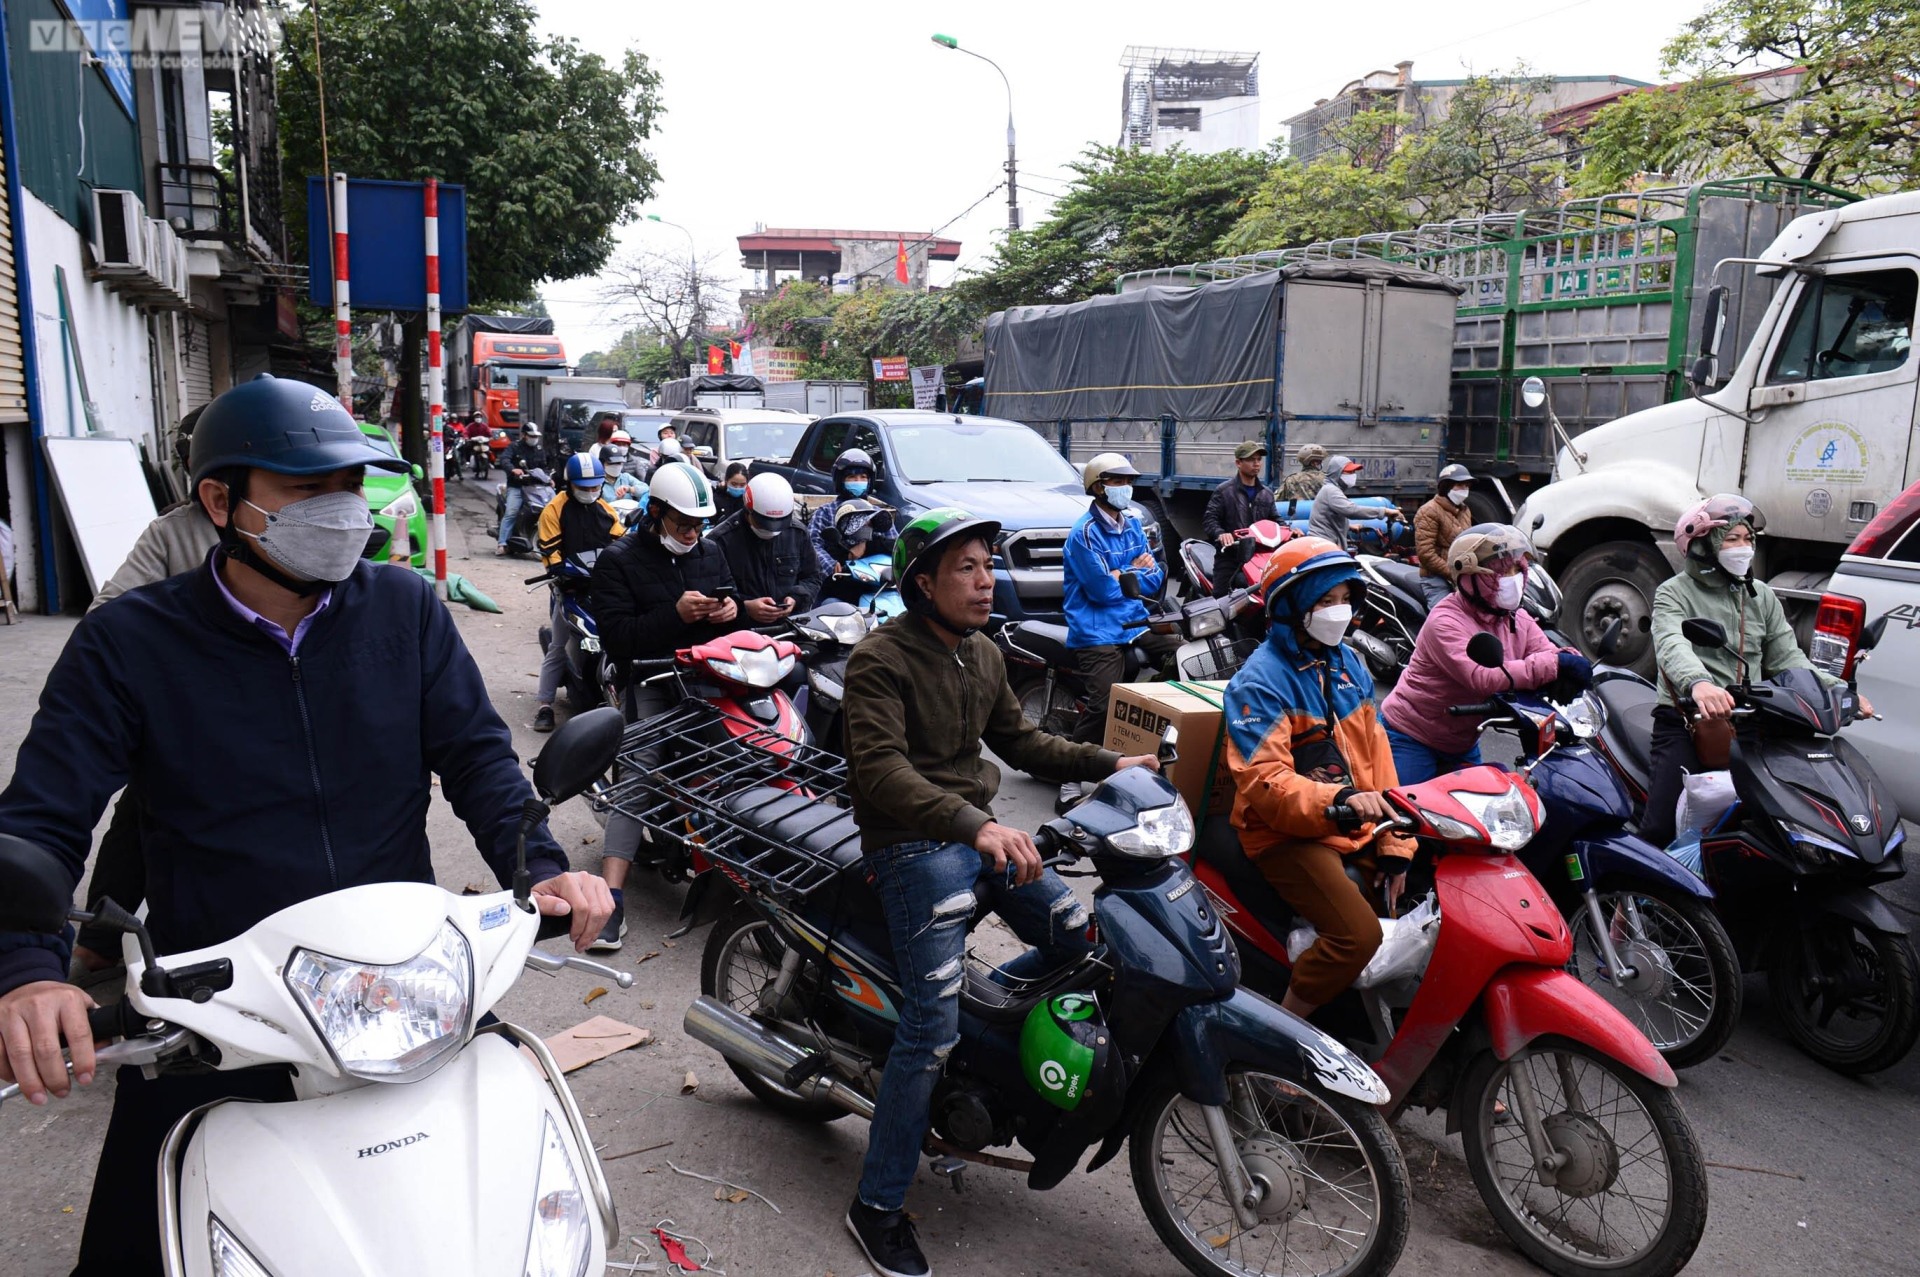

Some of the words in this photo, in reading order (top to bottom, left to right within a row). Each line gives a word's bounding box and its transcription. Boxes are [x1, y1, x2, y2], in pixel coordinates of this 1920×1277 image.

[1168, 879, 1195, 901] HONDA
[1067, 1073, 1080, 1099] gojek
[357, 1132, 430, 1159] HONDA
